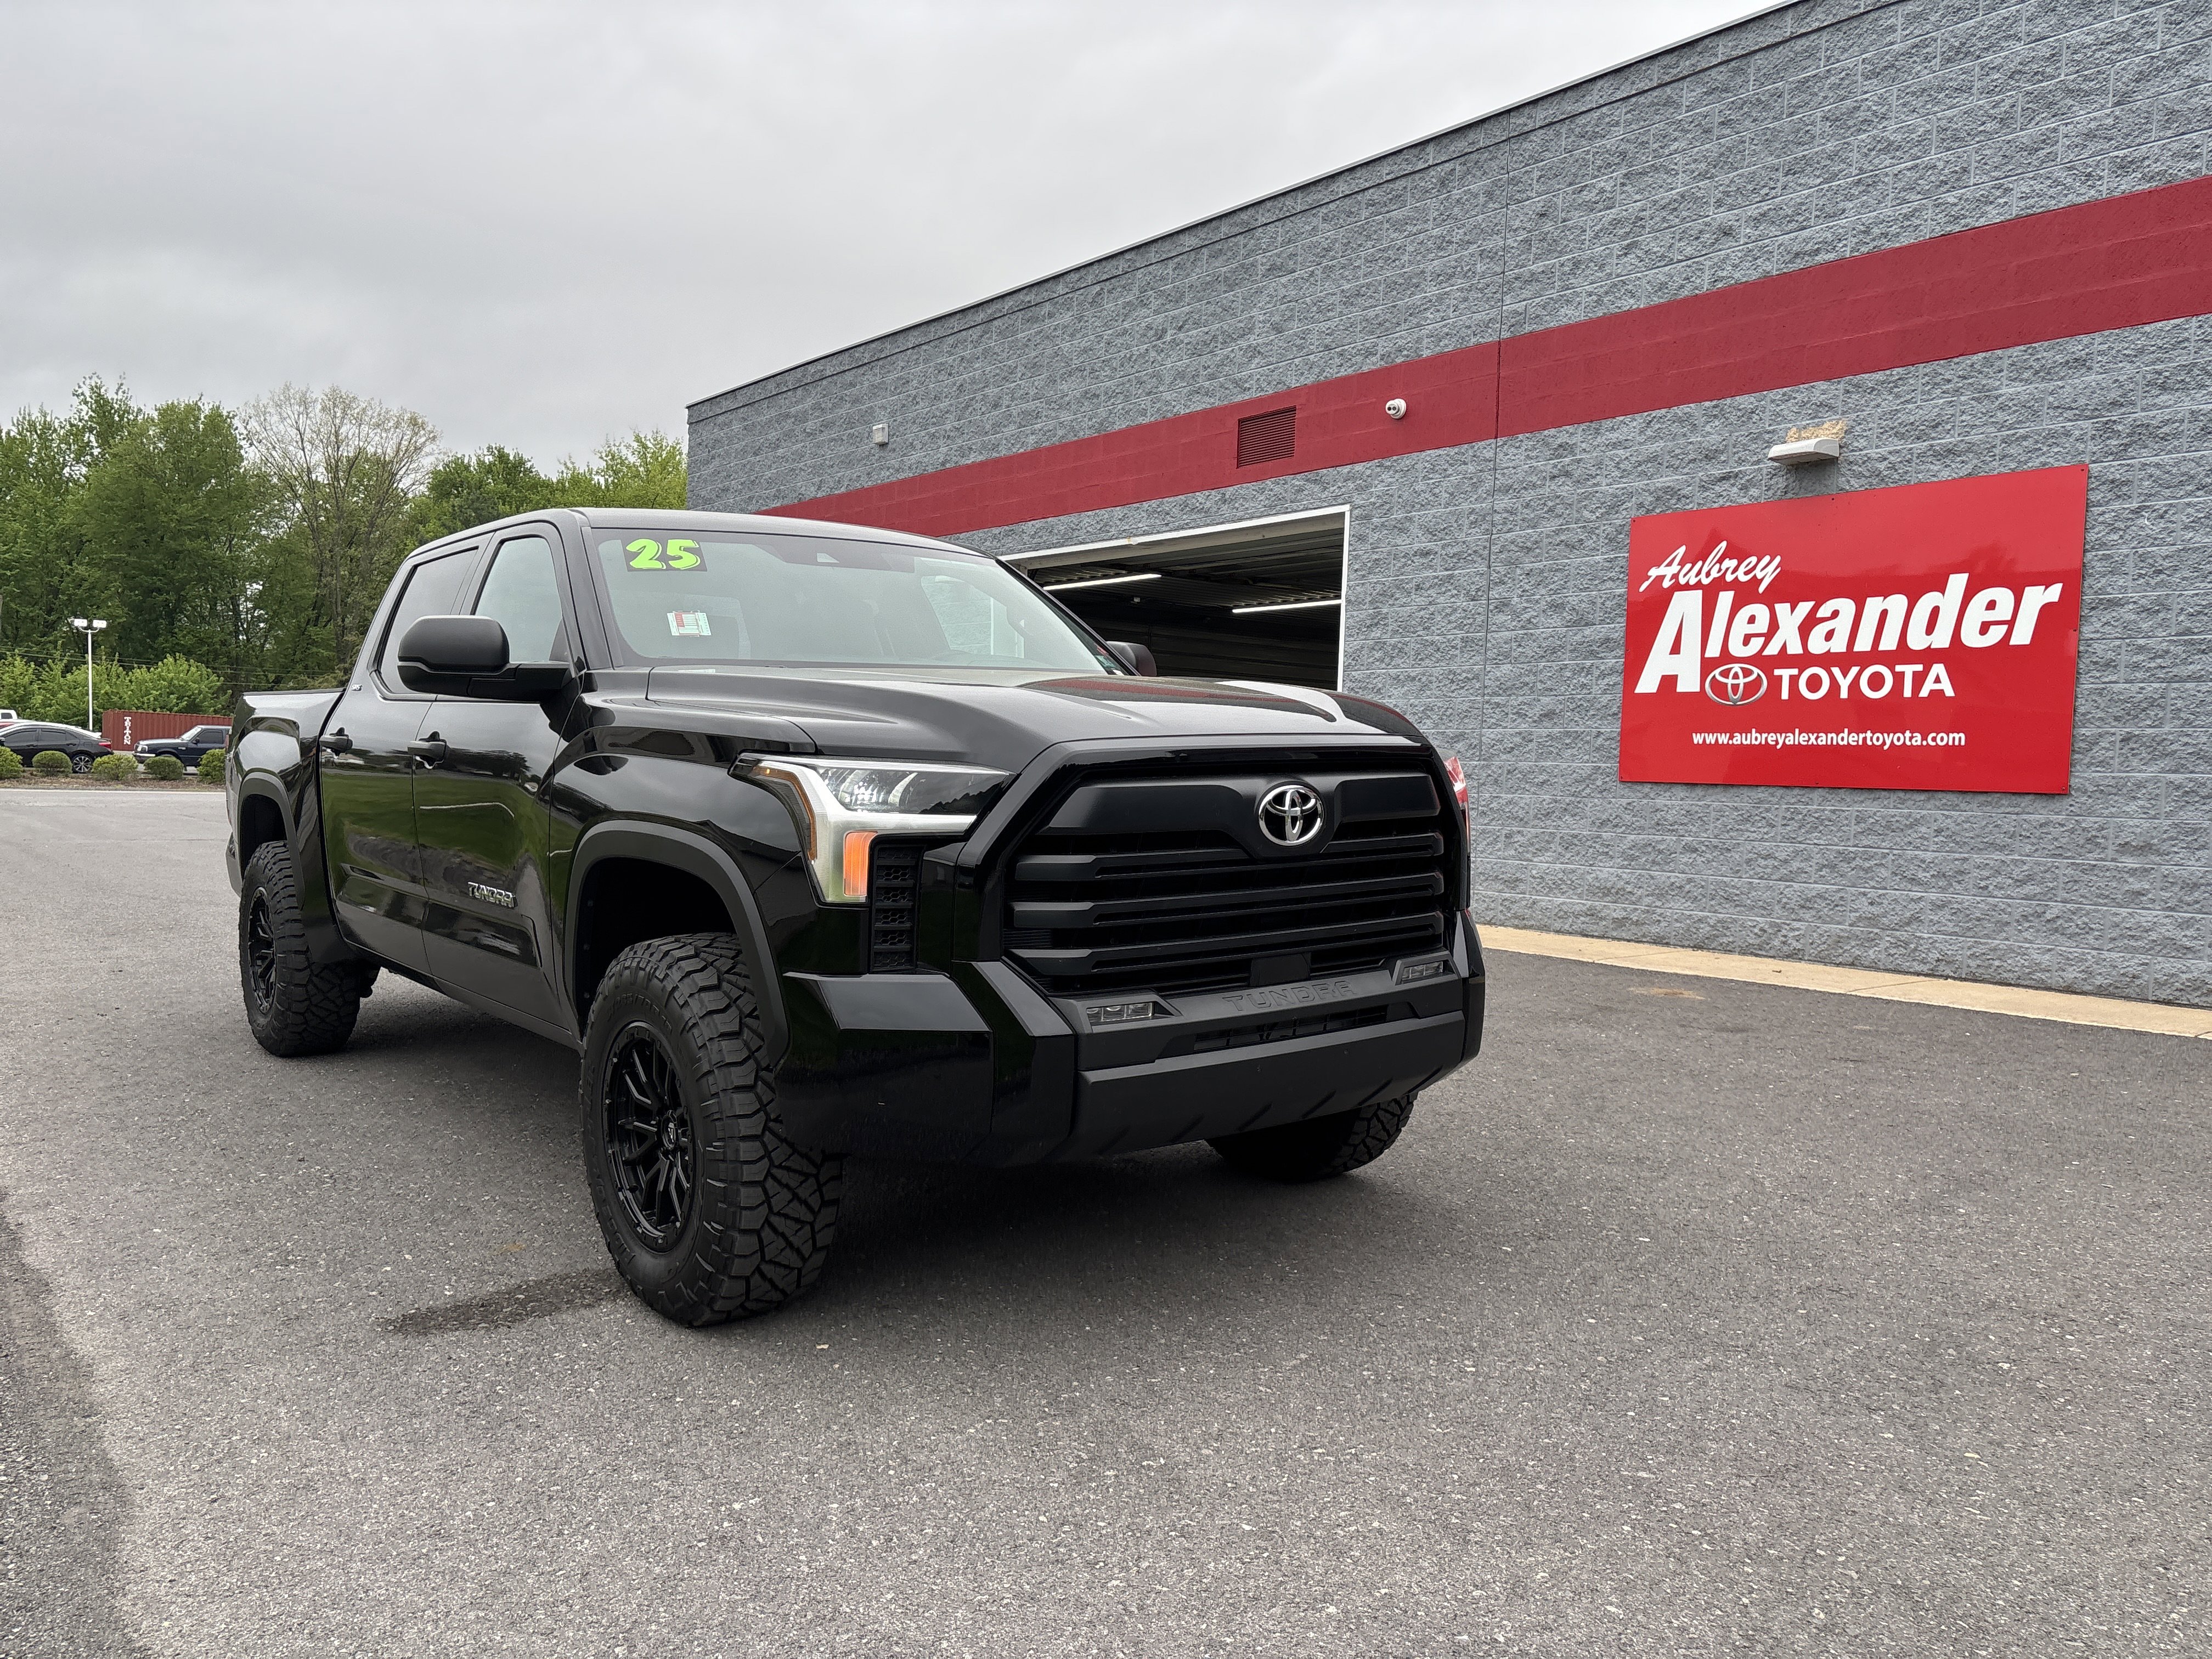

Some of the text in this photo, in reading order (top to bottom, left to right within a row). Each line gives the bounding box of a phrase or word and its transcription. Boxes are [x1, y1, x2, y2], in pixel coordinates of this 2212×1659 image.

[625, 538, 701, 569] 25
[1639, 540, 1781, 594] Aubrey
[1634, 572, 2063, 693] Alexander
[1773, 663, 1955, 700] TOYOTA
[123, 716, 132, 745] TRITON
[1692, 728, 1966, 751] www.aubreyalexandertoyota.com
[467, 882, 516, 908] TUNDRA
[1222, 980, 1357, 1012] TUNDRA
